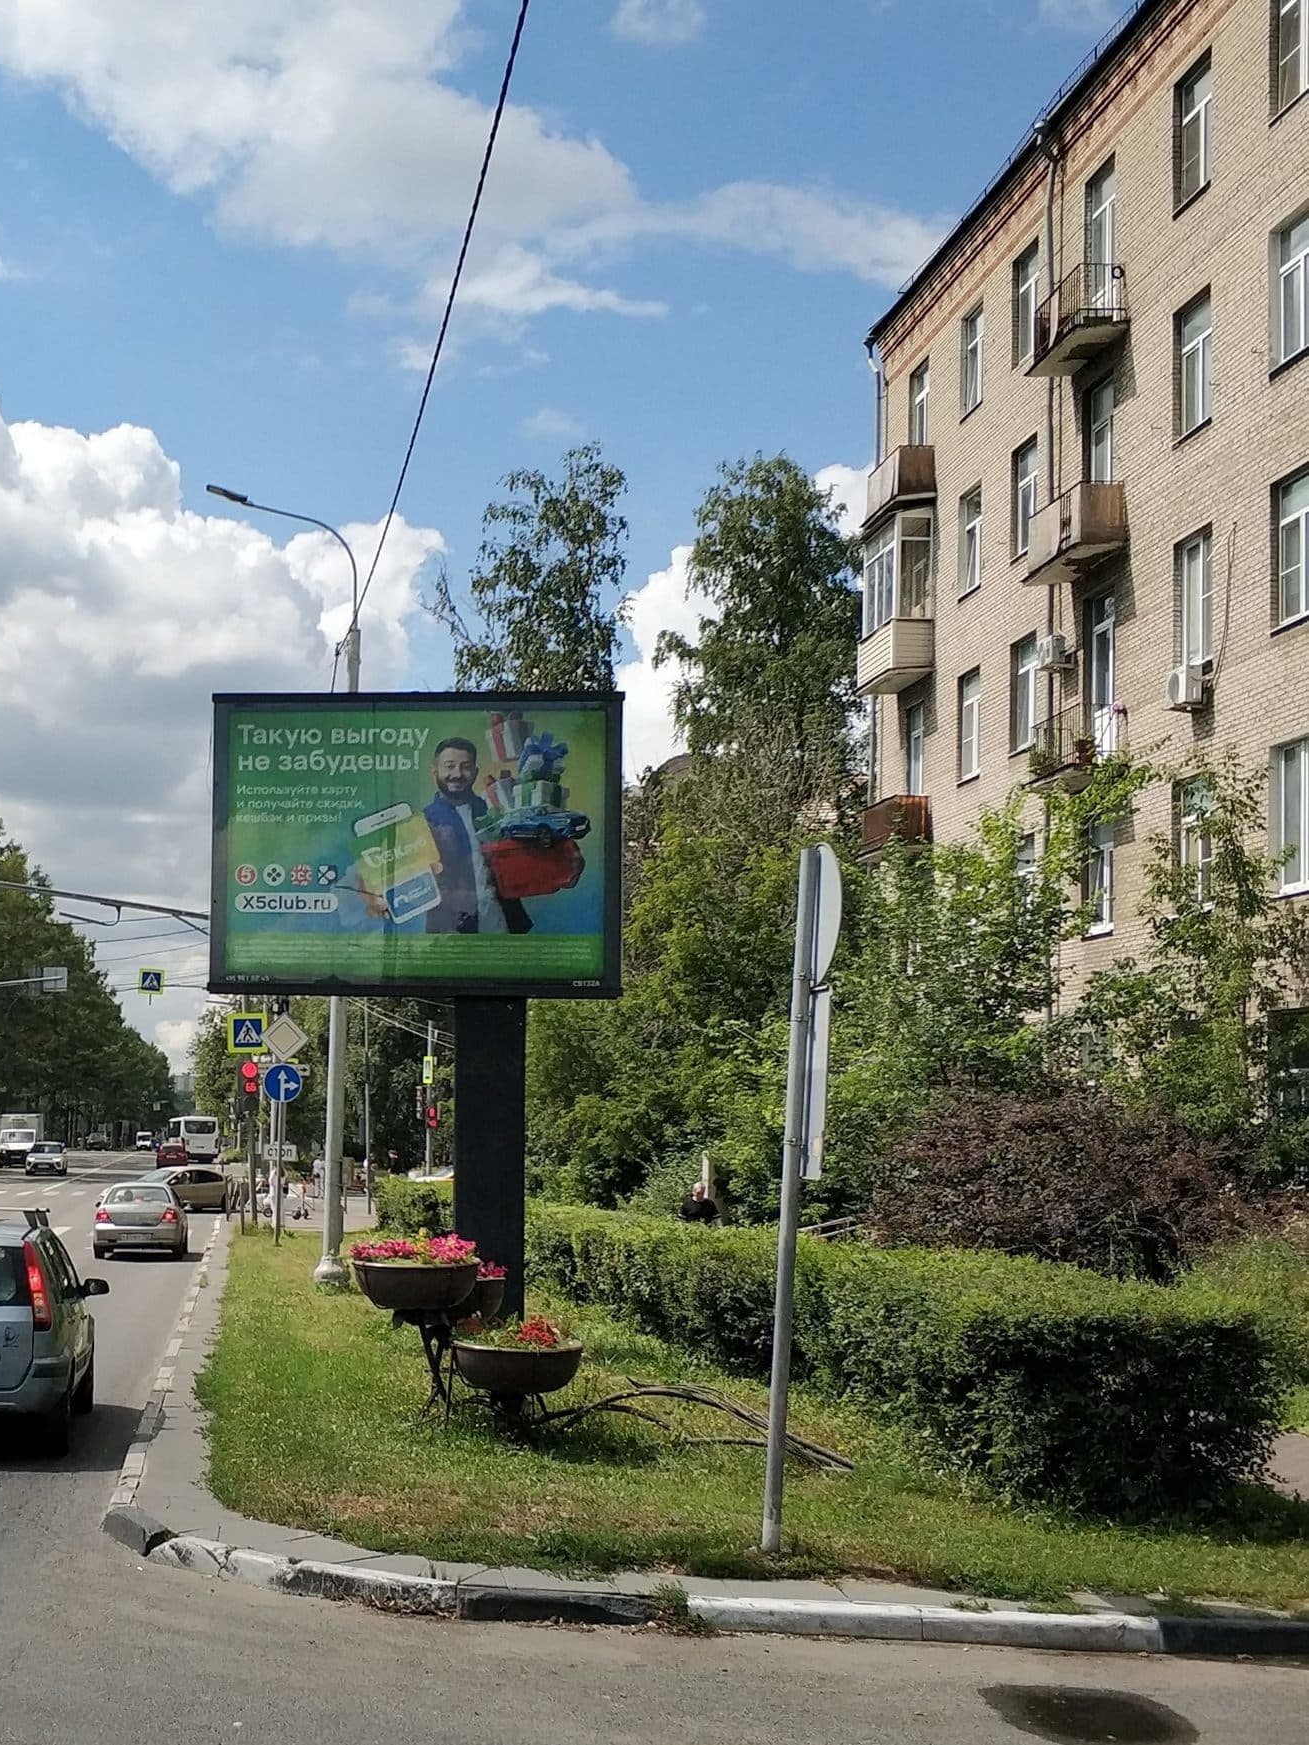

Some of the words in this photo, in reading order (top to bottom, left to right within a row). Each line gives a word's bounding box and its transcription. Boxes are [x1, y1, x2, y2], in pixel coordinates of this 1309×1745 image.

[237, 724, 322, 749] Такую
[330, 727, 430, 749] выгоду
[238, 754, 271, 771] не
[278, 749, 420, 776] забудешь!
[236, 784, 319, 797] Используйте
[321, 786, 358, 796] карту
[248, 798, 314, 811] получайте
[235, 811, 283, 823] кешбэк
[286, 814, 295, 822] и
[297, 811, 342, 824] призы!
[242, 895, 331, 910] X5club.ru
